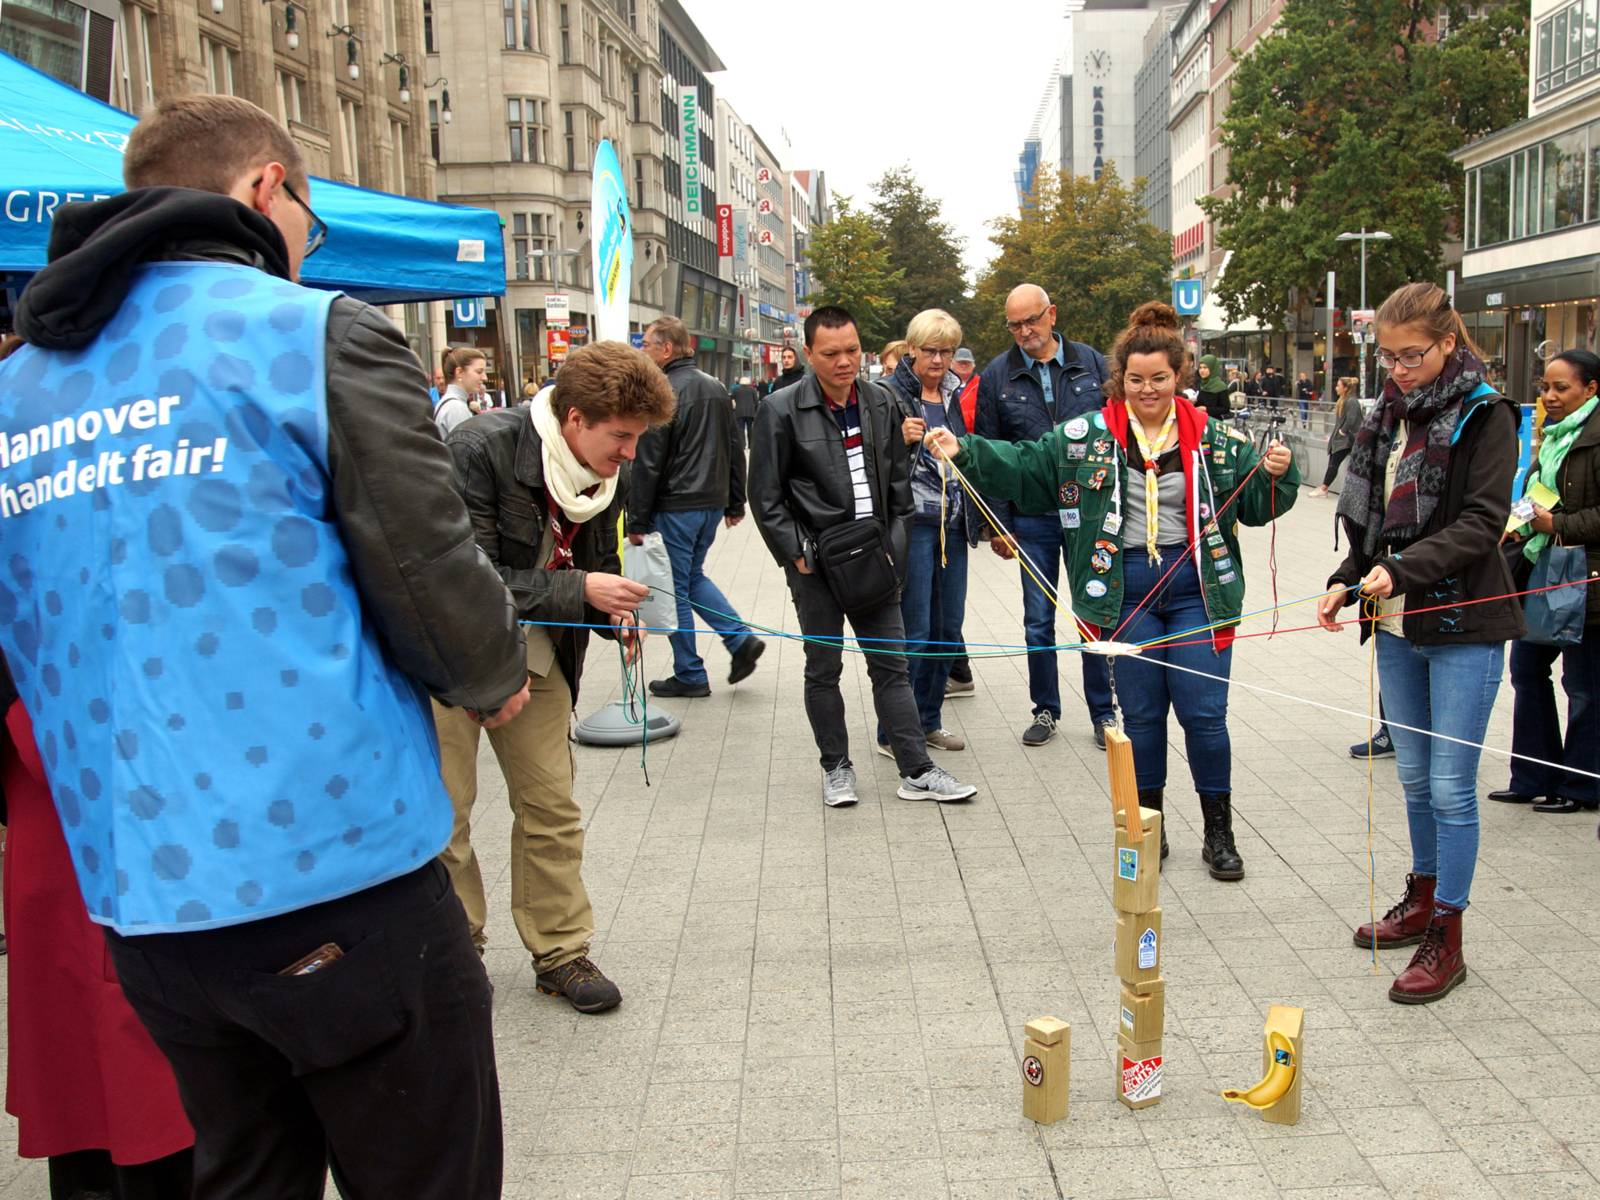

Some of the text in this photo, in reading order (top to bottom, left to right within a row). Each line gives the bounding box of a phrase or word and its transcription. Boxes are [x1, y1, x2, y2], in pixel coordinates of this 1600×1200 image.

[683, 95, 699, 212] DEICHMANN
[722, 219, 730, 254] vodafone
[456, 298, 475, 322] U
[1179, 283, 1198, 310] U
[0, 437, 228, 518] handelt fair!
